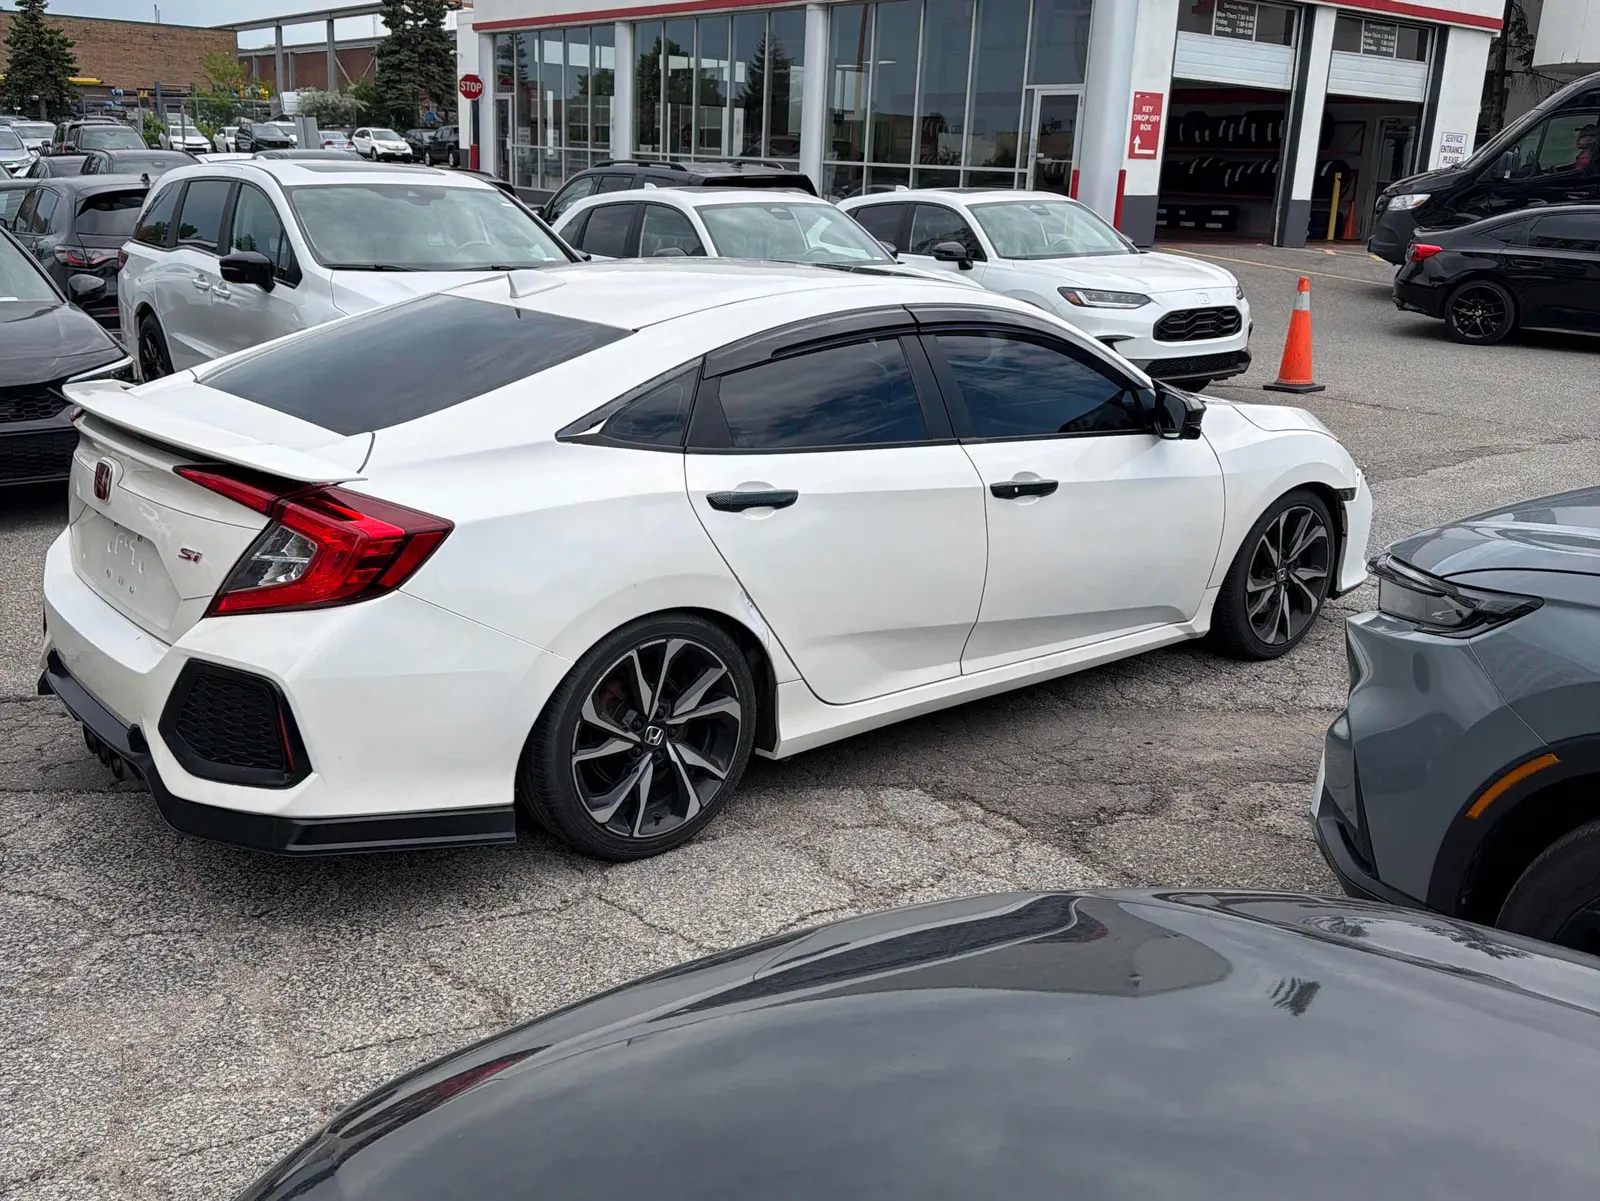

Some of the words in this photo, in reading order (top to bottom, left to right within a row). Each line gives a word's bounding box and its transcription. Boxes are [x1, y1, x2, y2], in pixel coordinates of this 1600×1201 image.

[1223, 2, 1238, 10] Service
[1216, 17, 1229, 26] Friday
[1215, 24, 1233, 34] Saturday
[460, 80, 482, 93] STOP
[1142, 105, 1154, 113] KEY
[1133, 113, 1150, 122] DROP
[1140, 123, 1152, 131] BOX
[1445, 134, 1464, 143] SERVICE
[1440, 144, 1464, 154] ENTRANCE
[1443, 155, 1460, 165] PLEASE
